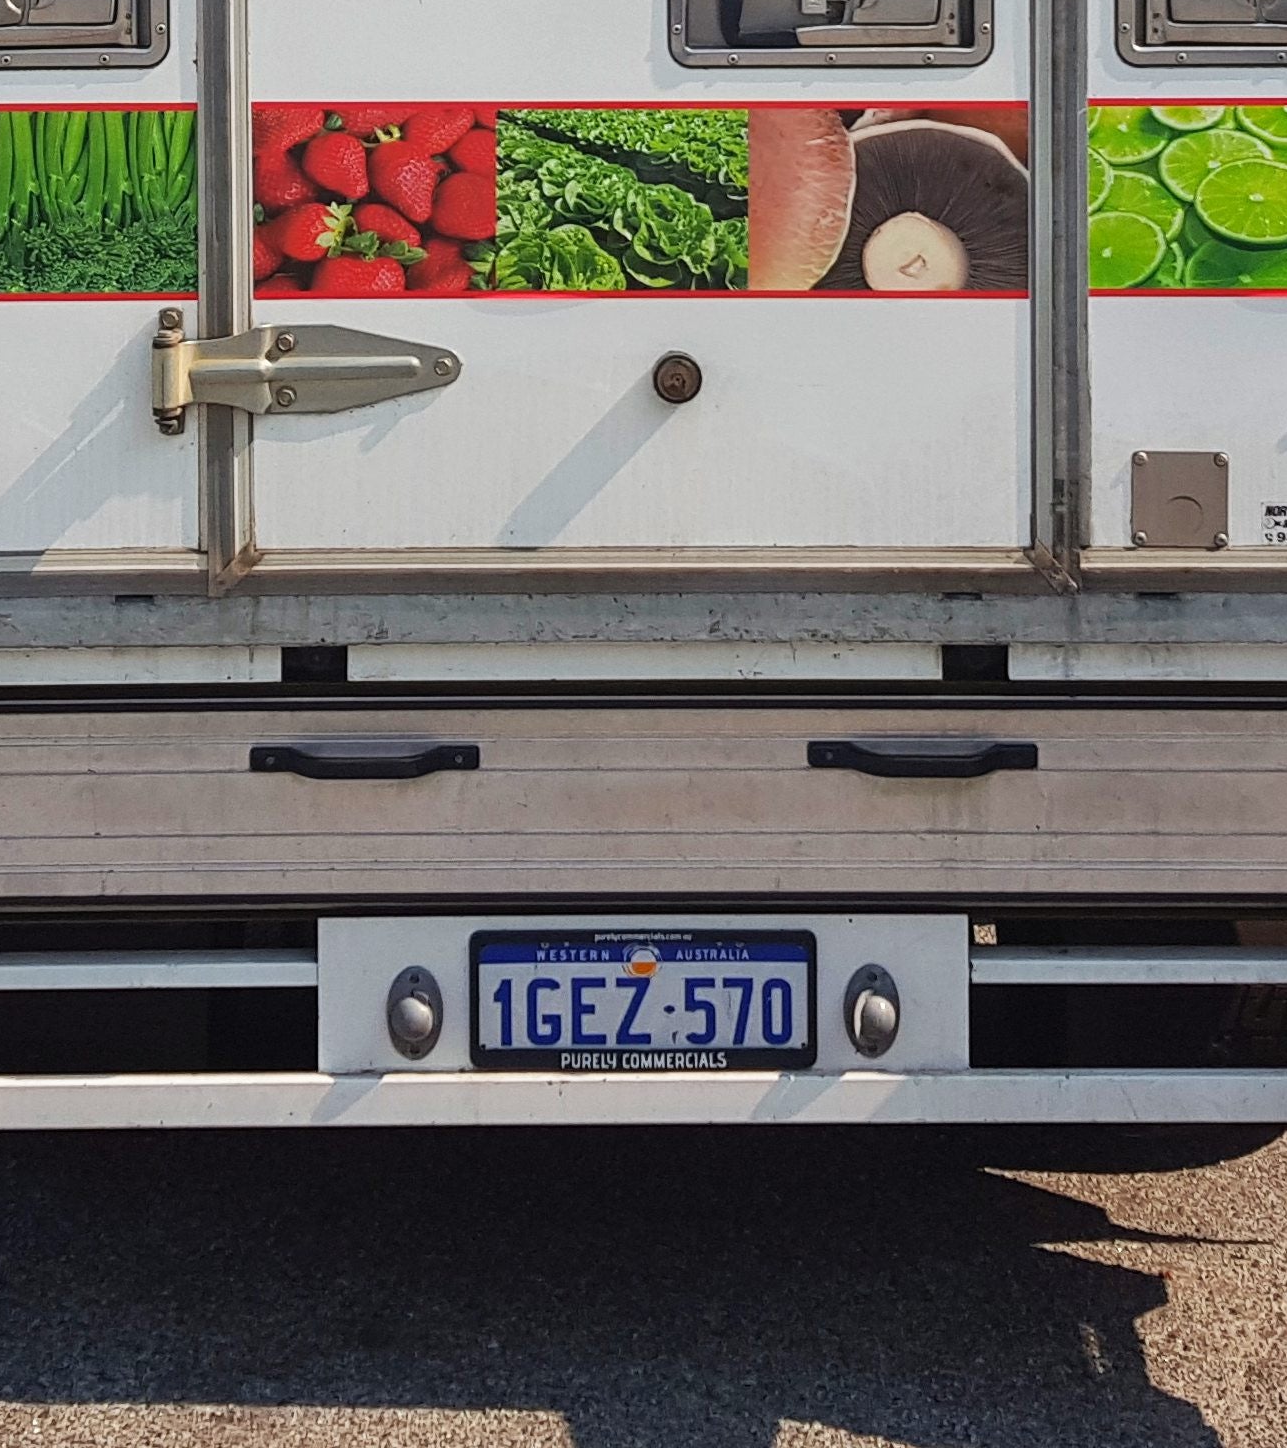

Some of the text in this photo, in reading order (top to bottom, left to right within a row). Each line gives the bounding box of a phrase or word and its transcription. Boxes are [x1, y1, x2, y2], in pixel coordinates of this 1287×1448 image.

[536, 948, 750, 962] WESTERN AUSTRALIA
[560, 1051, 727, 1070] PURELY COMMERCIALS
